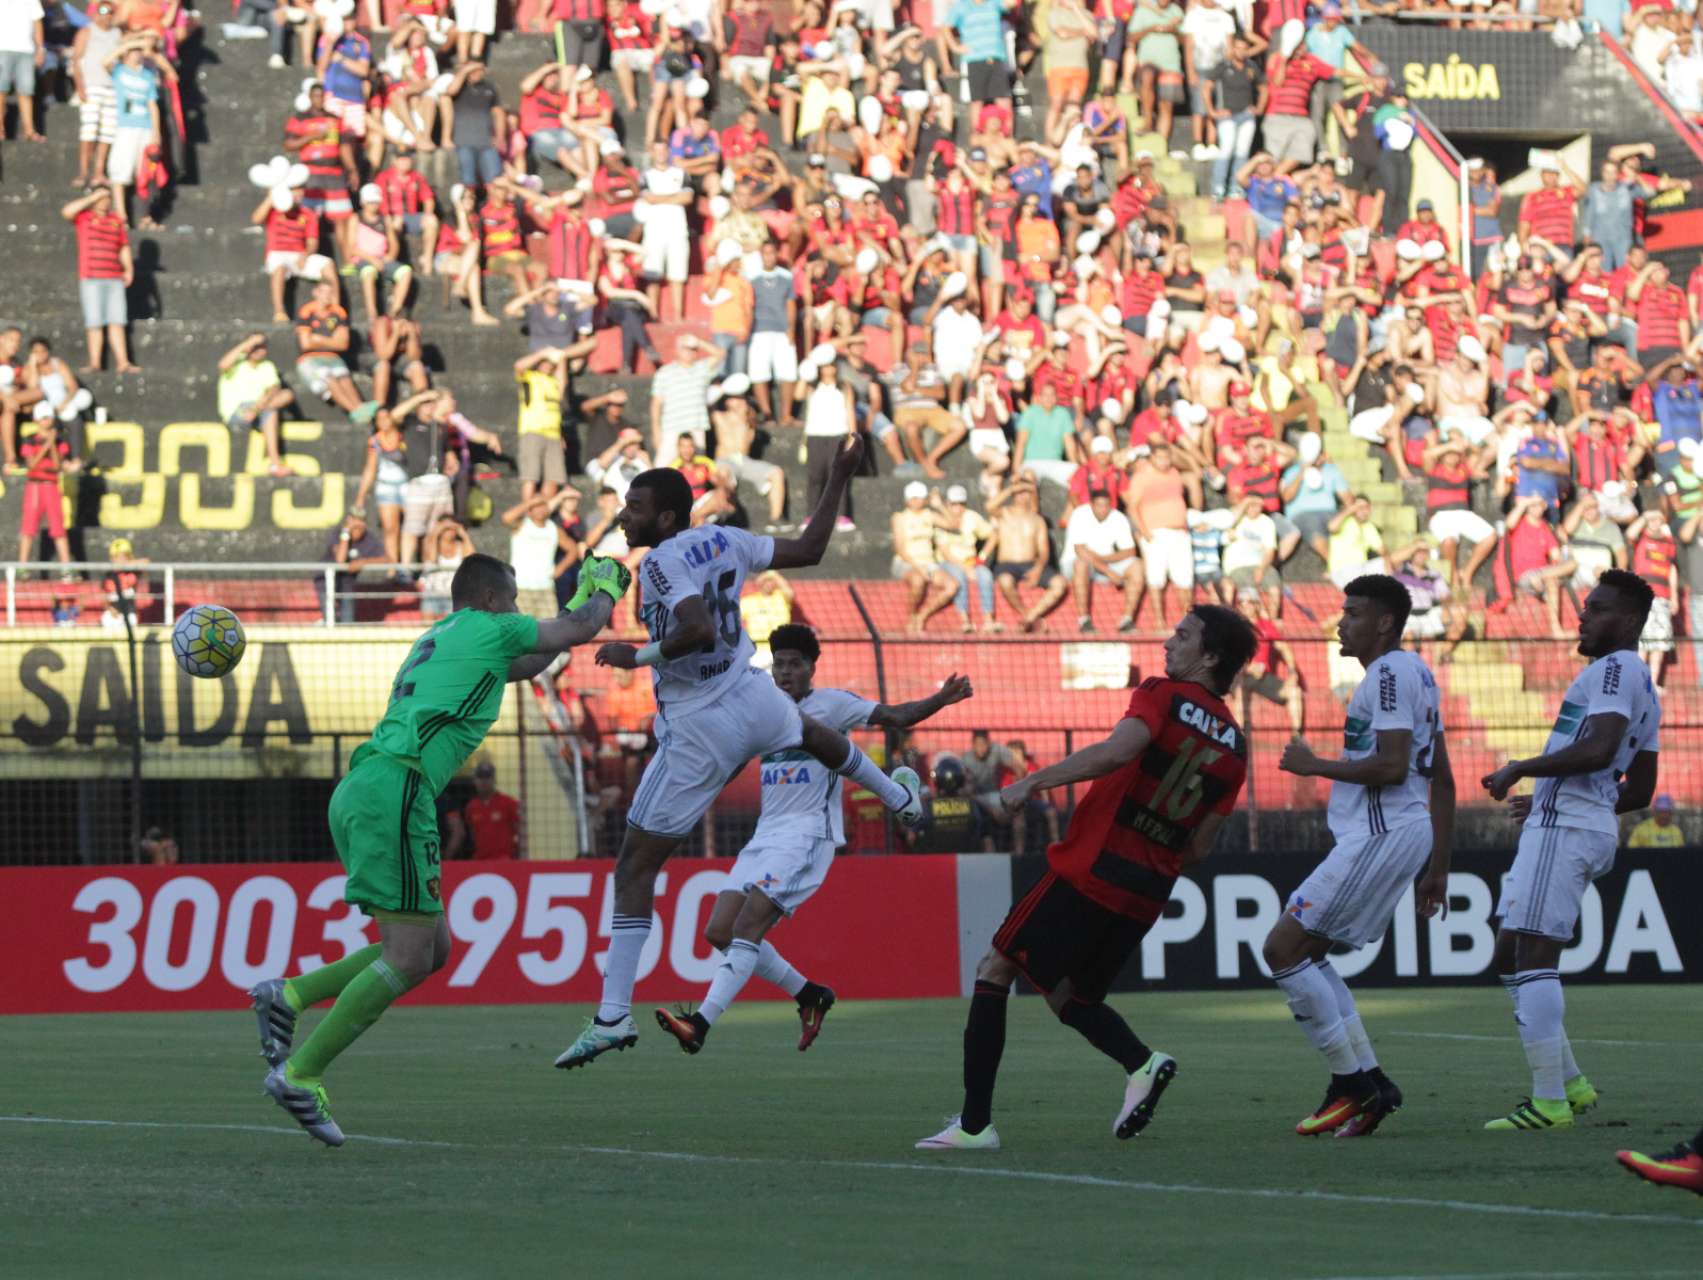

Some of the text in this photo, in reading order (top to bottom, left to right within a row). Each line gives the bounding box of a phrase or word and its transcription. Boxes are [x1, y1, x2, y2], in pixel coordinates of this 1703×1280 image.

[1404, 54, 1501, 100] SAÍDA
[684, 531, 730, 569] CAIXA
[12, 632, 314, 748] SAÍDA
[1179, 702, 1236, 750] CAIXA
[760, 767, 811, 785] AIXA
[1147, 736, 1224, 820] 16
[424, 841, 440, 867] 12
